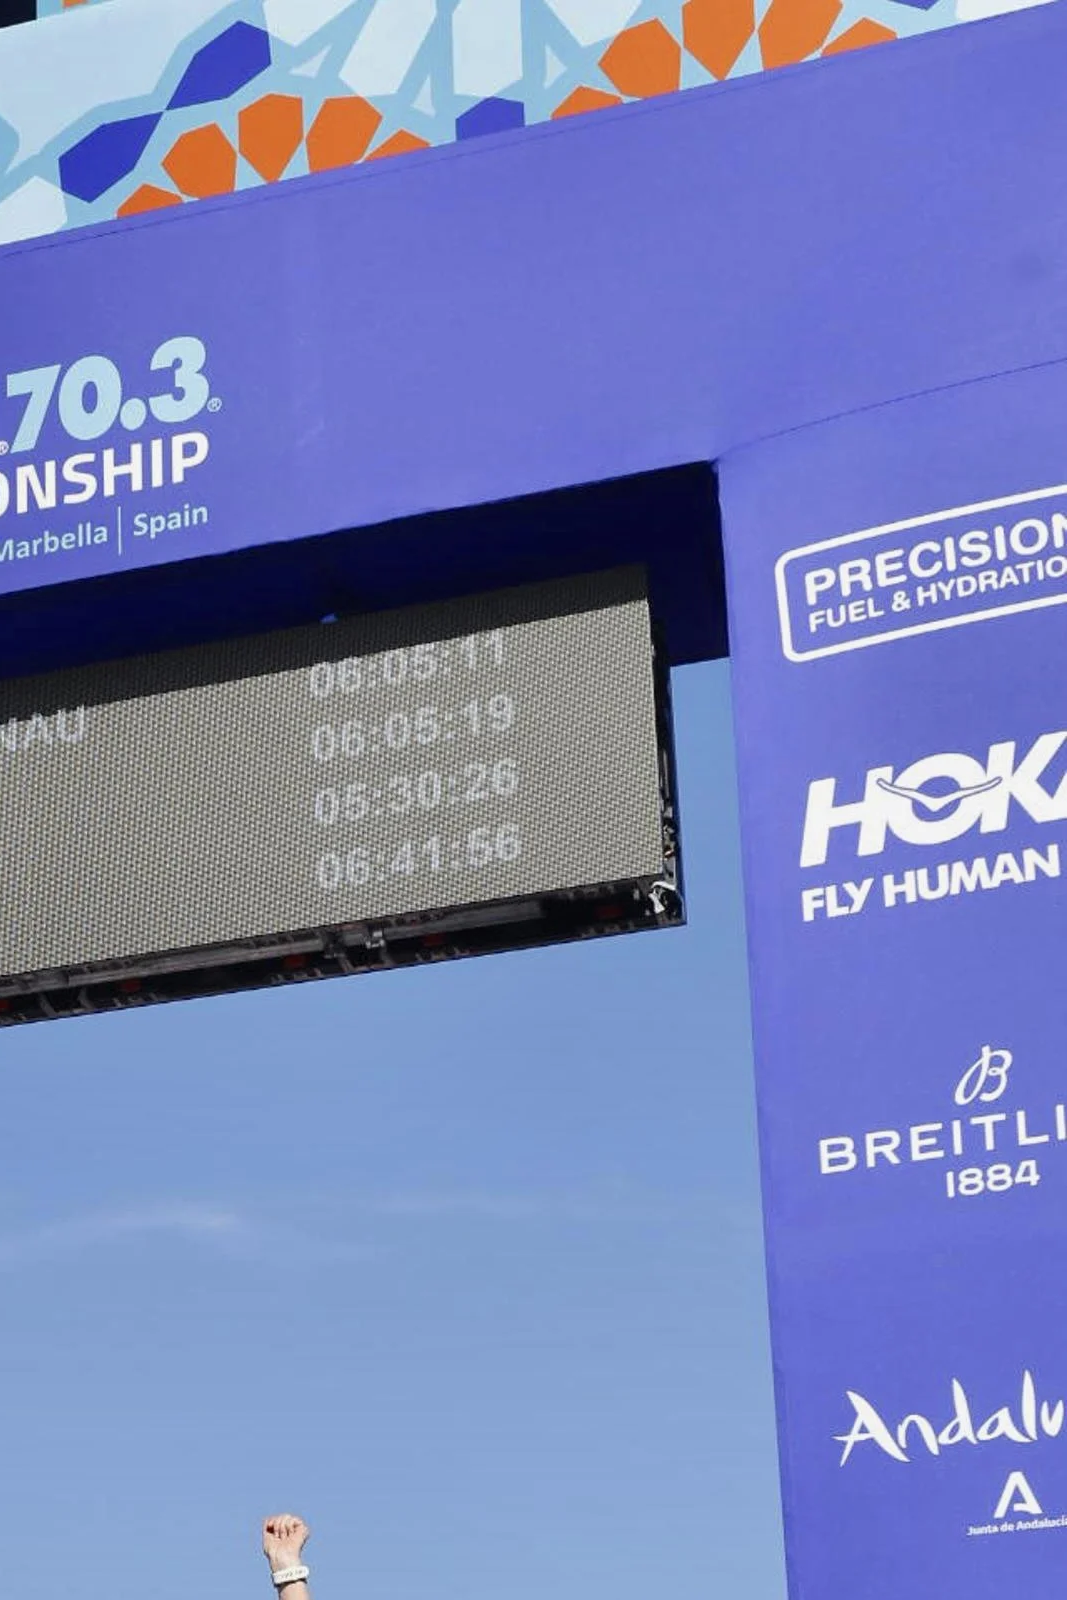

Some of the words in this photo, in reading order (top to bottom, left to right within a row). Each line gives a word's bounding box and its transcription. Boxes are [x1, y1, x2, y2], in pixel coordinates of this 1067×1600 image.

[6, 335, 211, 454] 70.3
[132, 503, 210, 544] Spain
[807, 598, 885, 634] FUEL
[891, 590, 912, 613] &
[310, 693, 515, 763] 06:05:19
[313, 757, 520, 827] 05:30:26
[315, 822, 522, 891] 06:41:56
[801, 877, 875, 923] FLY
[883, 843, 1061, 907] HUMAN
[946, 1159, 1041, 1199] 1884
[966, 1524, 999, 1536] Junta
[1000, 1521, 1015, 1532] de
